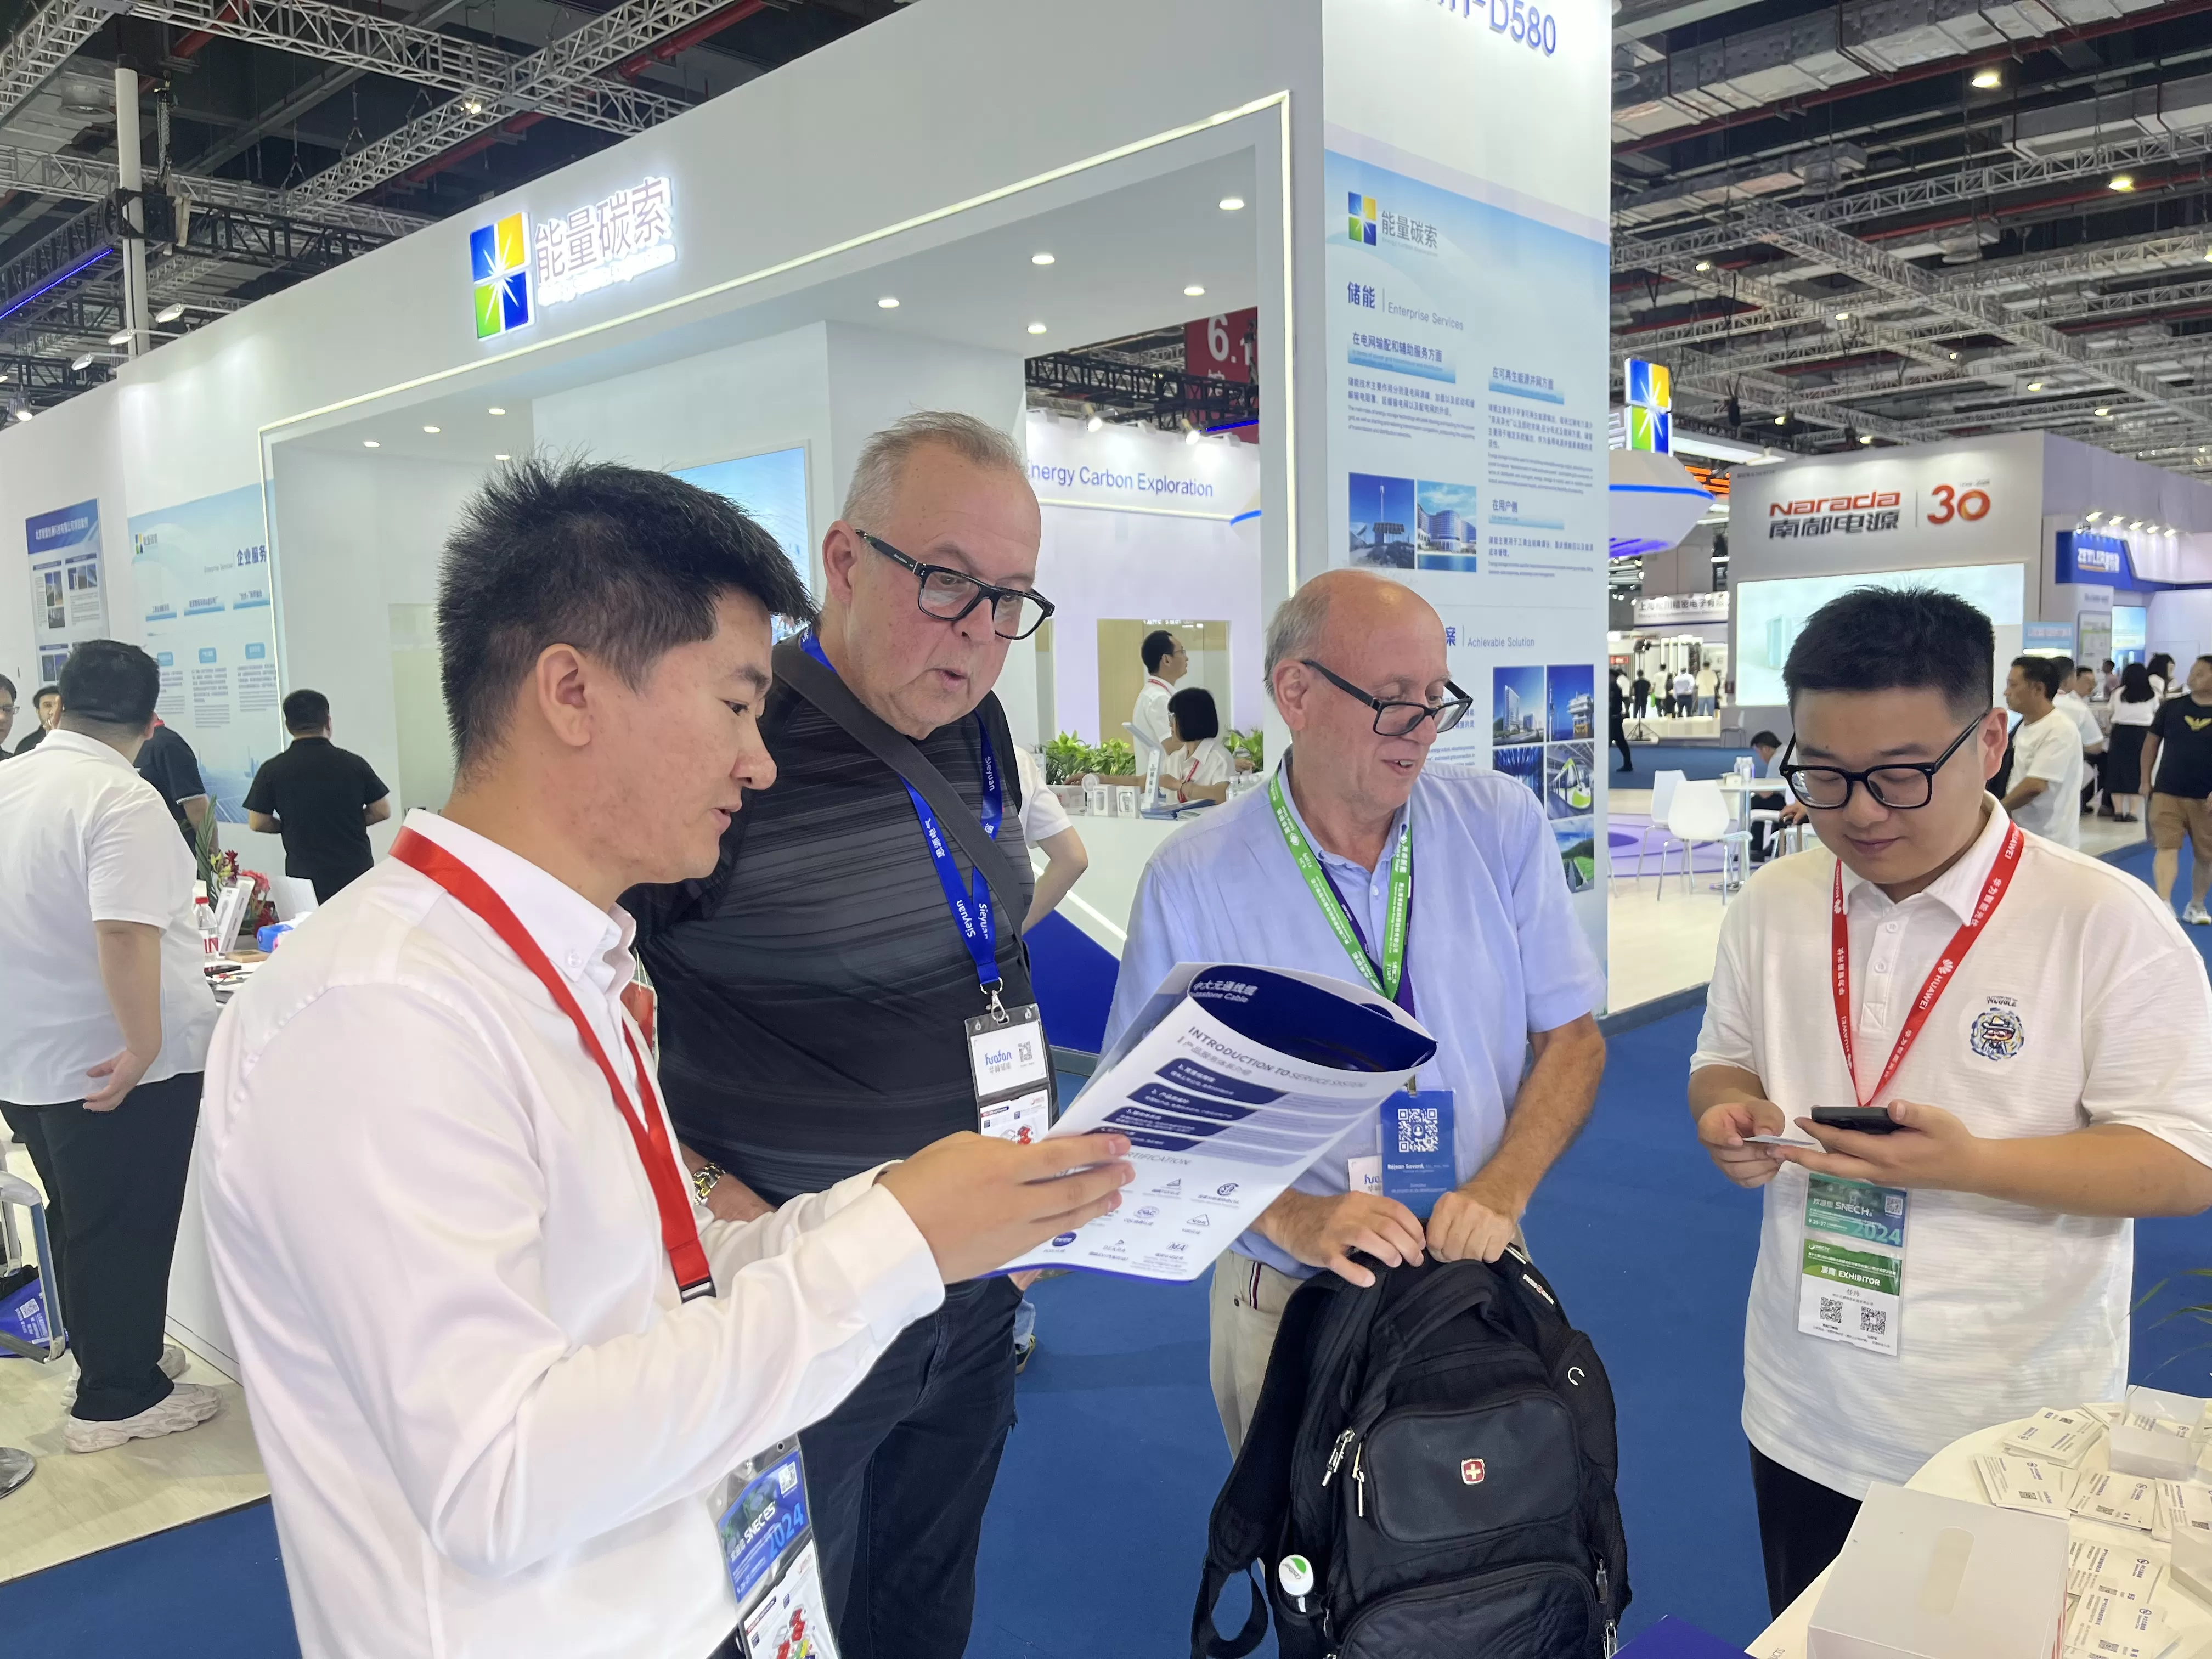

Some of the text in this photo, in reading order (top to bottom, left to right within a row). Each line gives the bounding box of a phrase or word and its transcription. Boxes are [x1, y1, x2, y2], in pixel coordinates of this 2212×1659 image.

[535, 179, 665, 284] 能量碳索
[1382, 210, 1437, 249] 能量碳索
[1347, 281, 1375, 309] 储能
[1388, 303, 1464, 330] Enterprise Services
[1352, 331, 1442, 363] 在电网输配和辅助服务方面
[1029, 462, 1213, 497] nergy Carbon Exploration
[1492, 499, 1517, 512] 在用户侧
[1769, 489, 1901, 517] Narada
[1927, 483, 1991, 525] 30
[1768, 508, 1900, 540] 南都电源
[236, 545, 266, 566] 企业服务
[1446, 626, 1455, 646] 案
[1468, 636, 1534, 647] Achievable Solution
[985, 757, 995, 791] Sieyuan
[956, 900, 976, 938] Sieyuan
[1224, 992, 1249, 1003] Cable
[1918, 974, 1943, 1011] HUAWEI
[1188, 1026, 1275, 1072] INTRODUCTION
[1275, 1066, 1290, 1076] TO
[1125, 1151, 1192, 1165] RTIFICATION
[1103, 1244, 1126, 1253] DEKRA
[1852, 1223, 1901, 1246] 2024
[1838, 1271, 1881, 1286] EXHIBITOR
[769, 1503, 804, 1560] 2024
